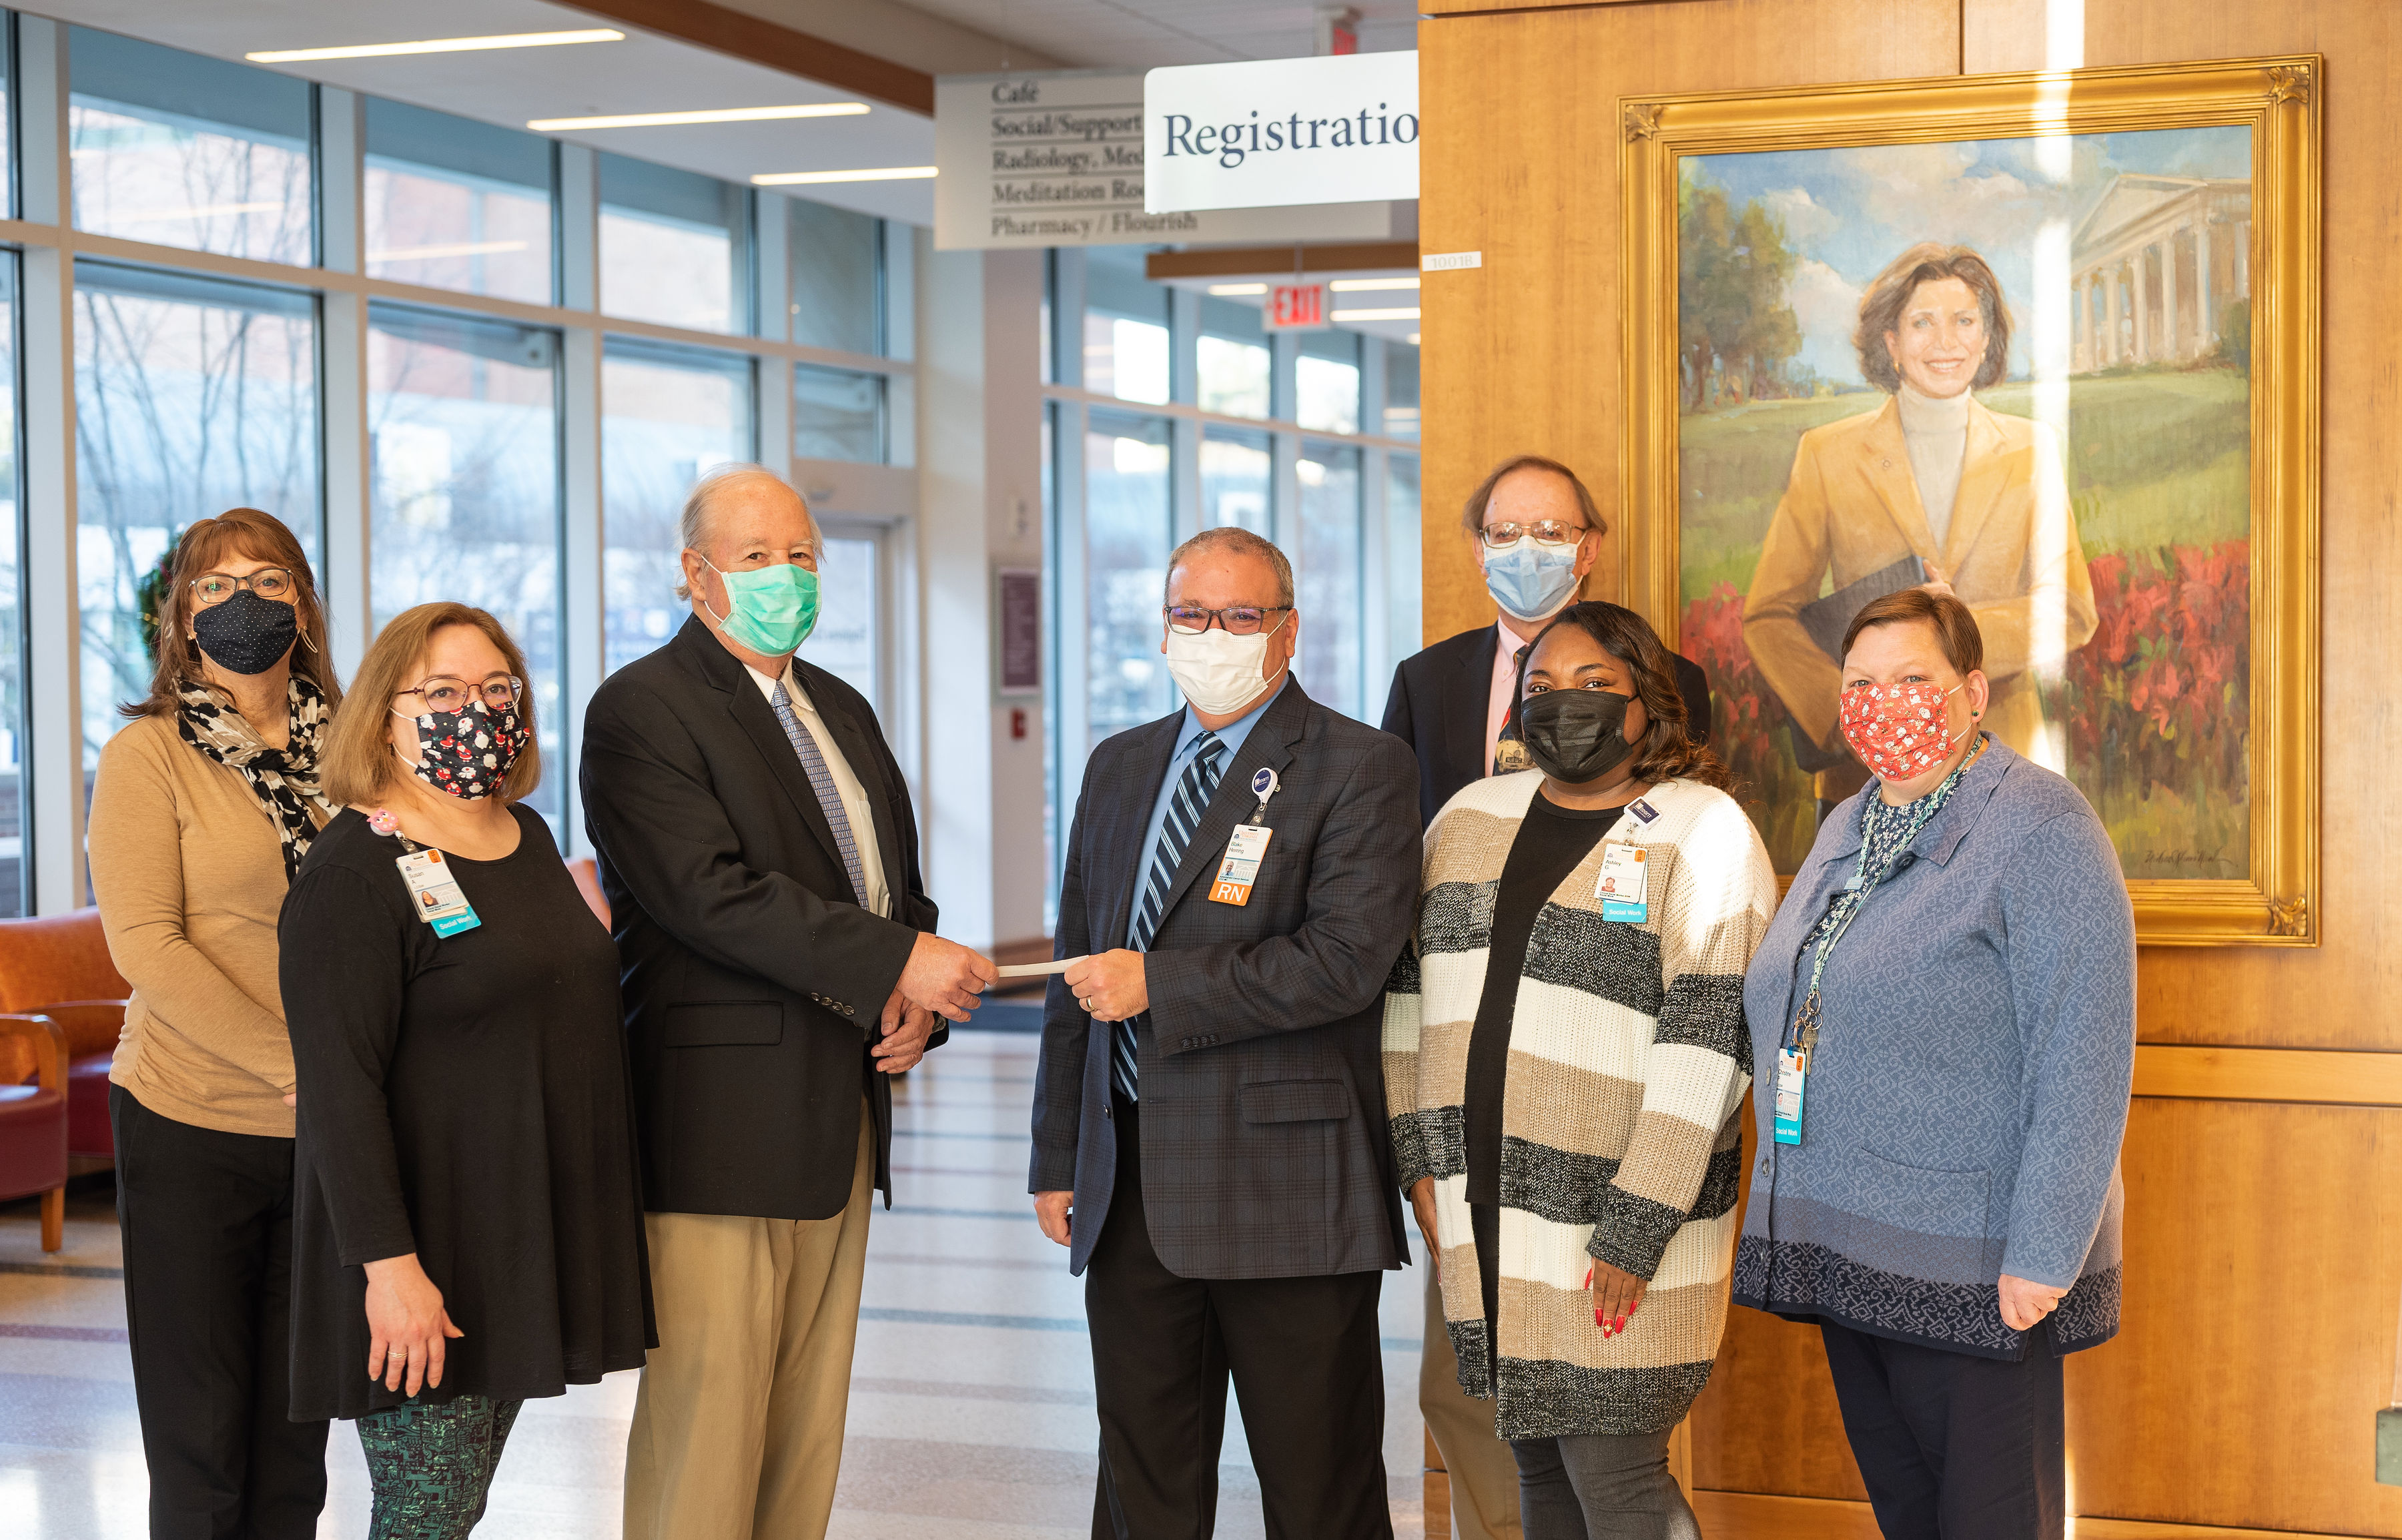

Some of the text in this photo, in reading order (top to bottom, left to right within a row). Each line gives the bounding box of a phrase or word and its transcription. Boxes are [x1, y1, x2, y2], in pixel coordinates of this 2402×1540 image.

[991, 81, 1039, 104] Café
[991, 113, 1142, 141] Social/Support
[1163, 103, 1419, 168] Registratio
[993, 147, 1099, 175] Radiology,
[992, 180, 1105, 203] Meditation
[992, 215, 1092, 240] Pharmacy
[1112, 212, 1197, 232] Flourish
[1274, 285, 1322, 326] EXIT
[1216, 883, 1244, 902] RN
[439, 915, 471, 929] Social Work
